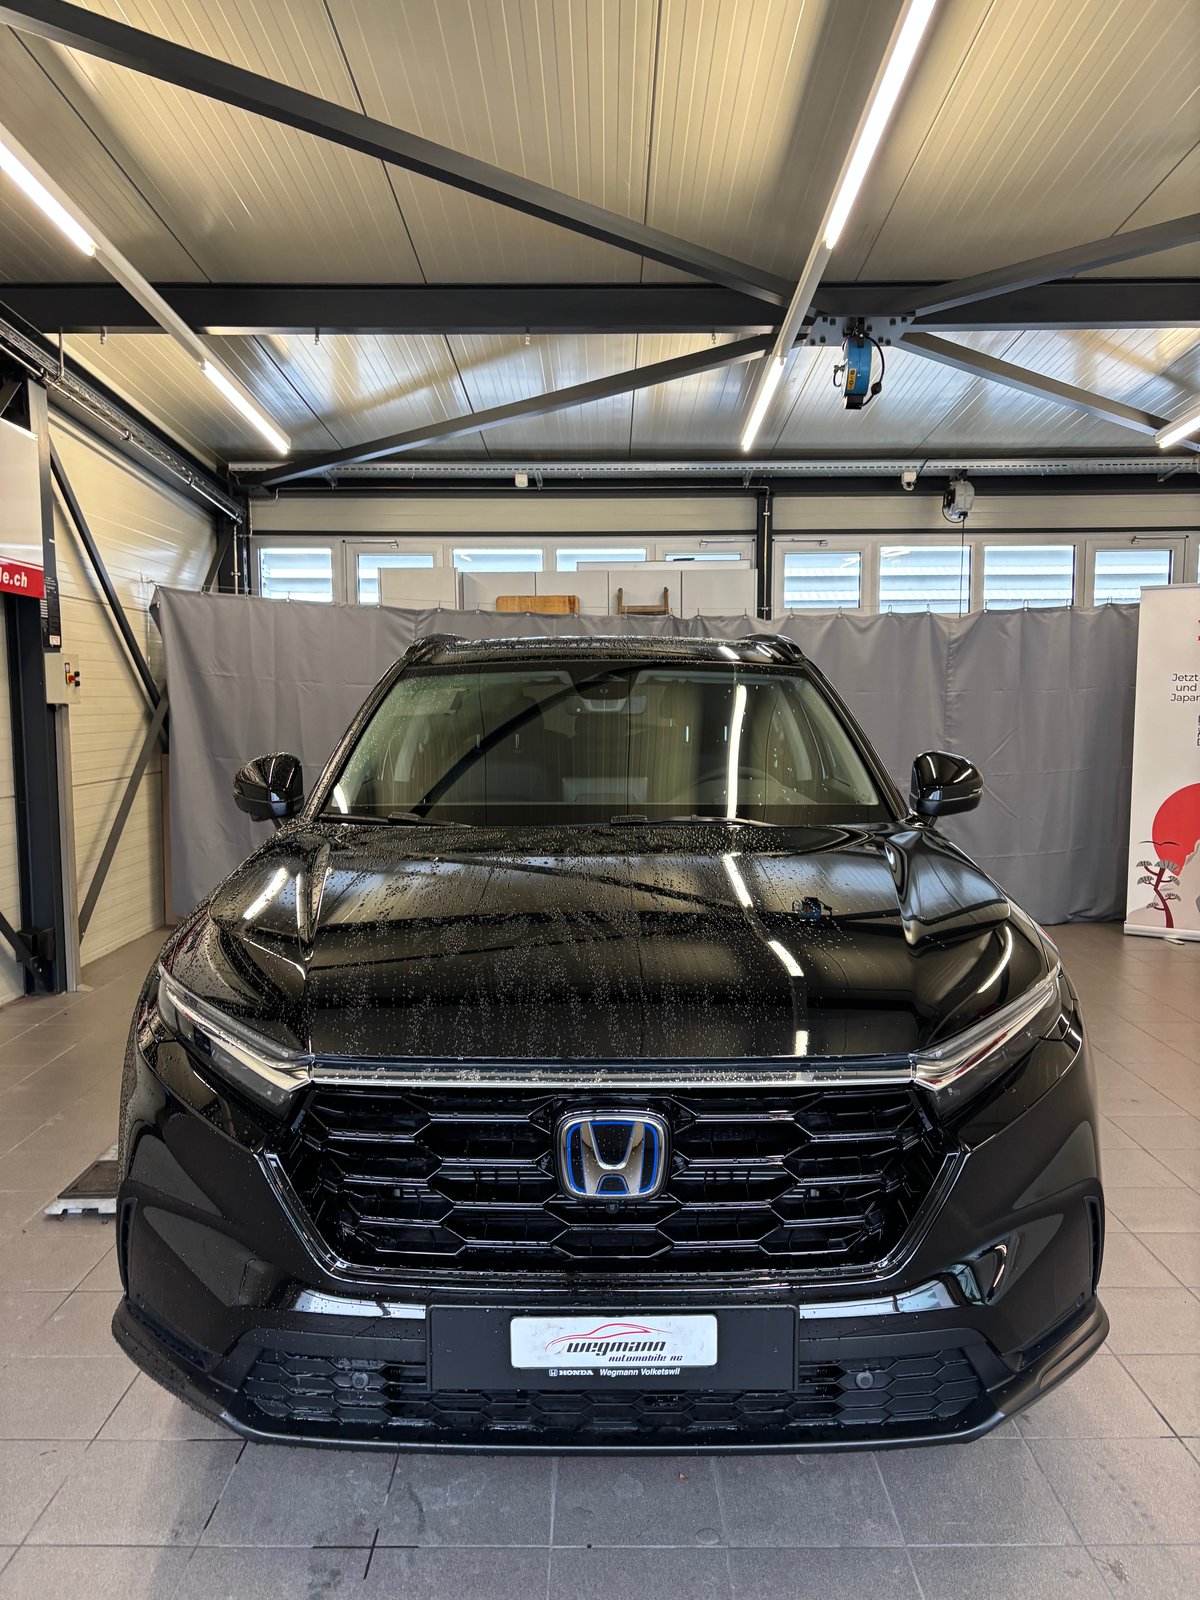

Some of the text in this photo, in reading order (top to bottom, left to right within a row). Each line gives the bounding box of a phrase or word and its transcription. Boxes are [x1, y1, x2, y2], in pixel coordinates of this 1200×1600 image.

[1172, 674, 1198, 682] Jetzt
[1176, 683, 1197, 692] und
[566, 1341, 666, 1356] wegmann
[608, 1354, 667, 1362] automobile
[599, 1368, 639, 1377] Wegmann
[640, 1367, 681, 1376] Volketswil
